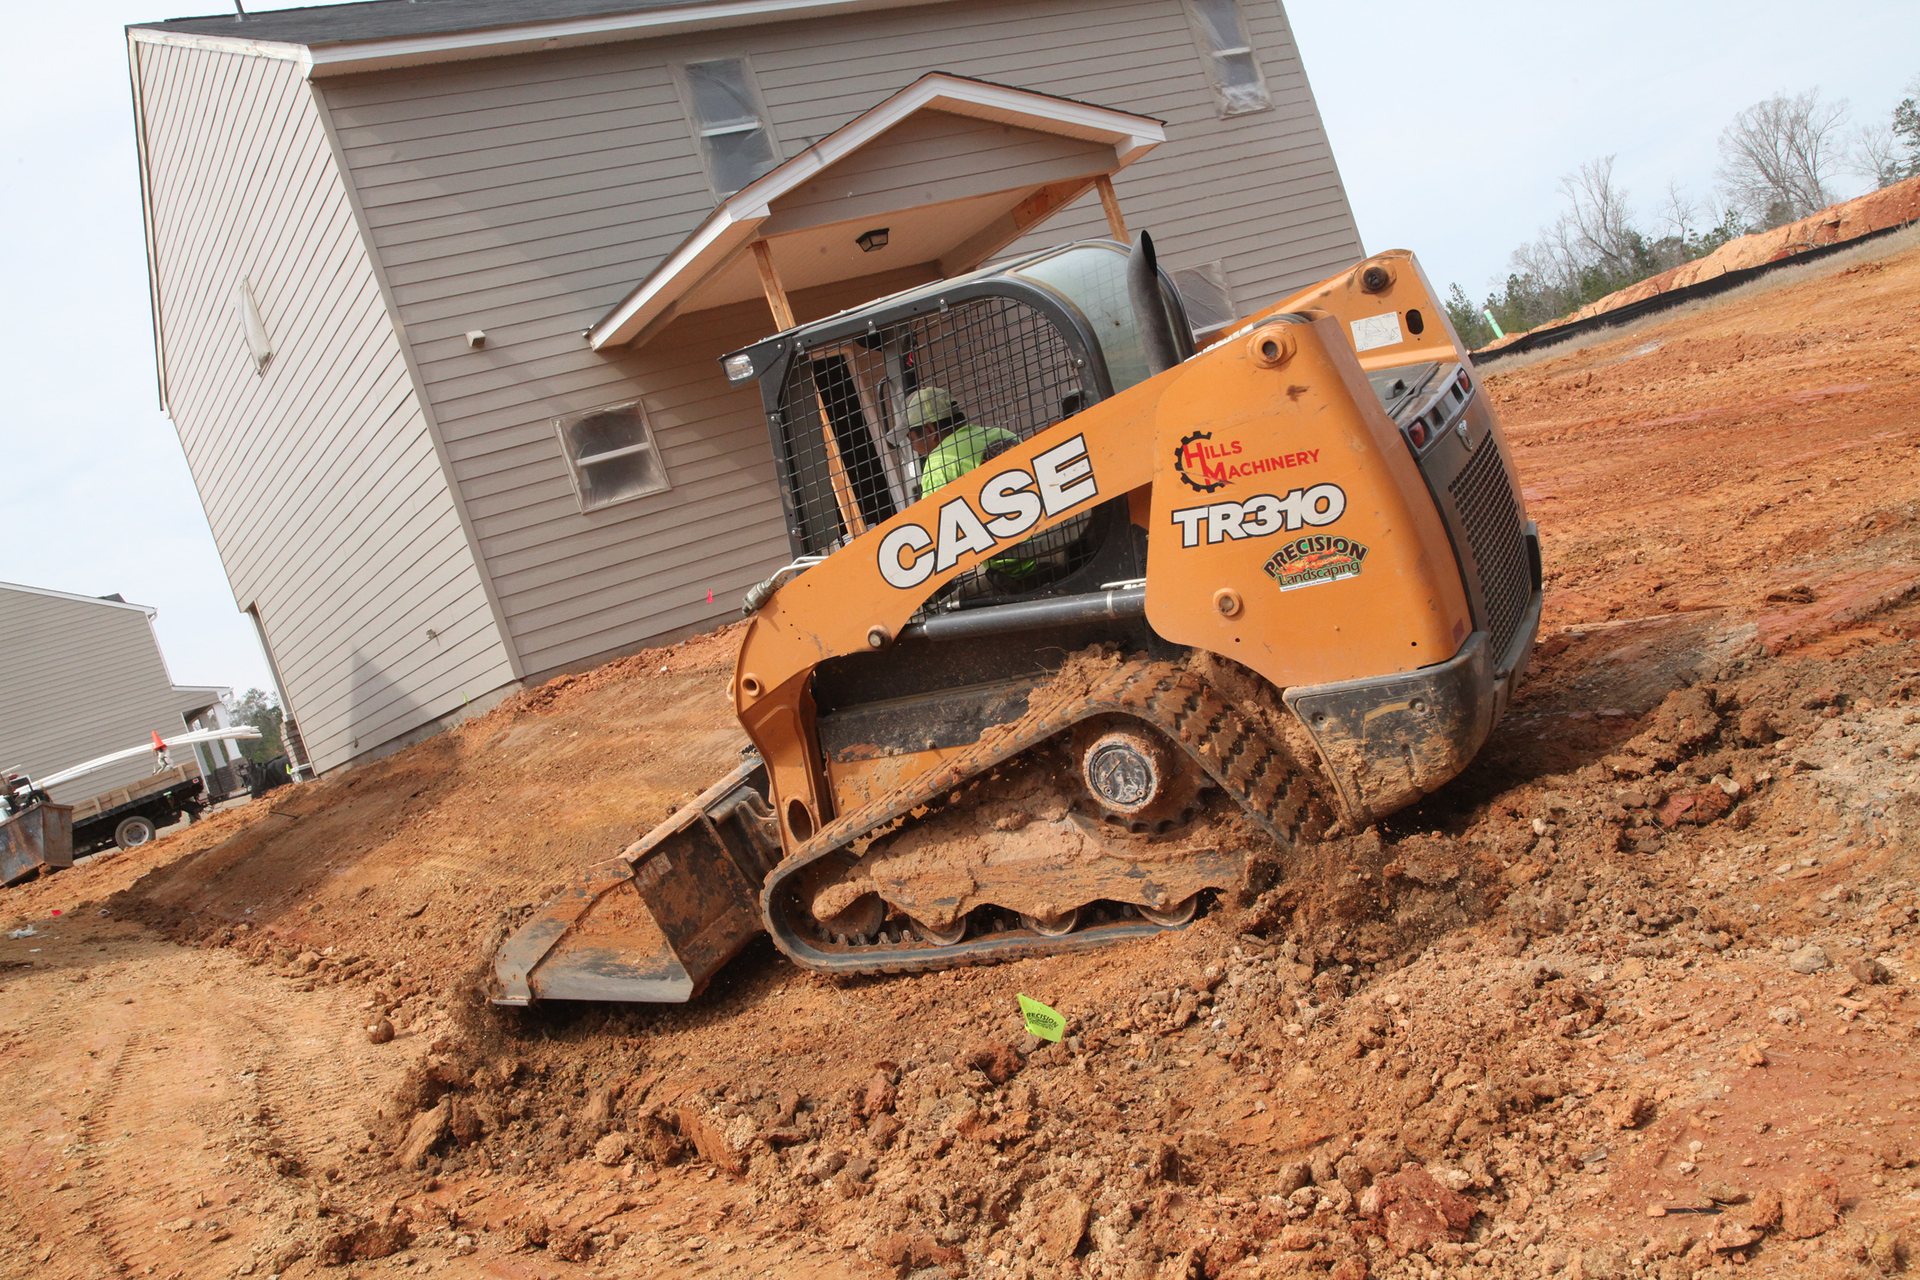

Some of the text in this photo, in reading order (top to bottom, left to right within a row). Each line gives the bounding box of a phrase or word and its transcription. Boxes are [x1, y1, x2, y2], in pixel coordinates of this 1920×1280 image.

[877, 432, 1099, 589] CASE
[1171, 482, 1347, 549] TR310
[1263, 536, 1368, 579] PRECISION
[1279, 561, 1361, 586] Landscaping
